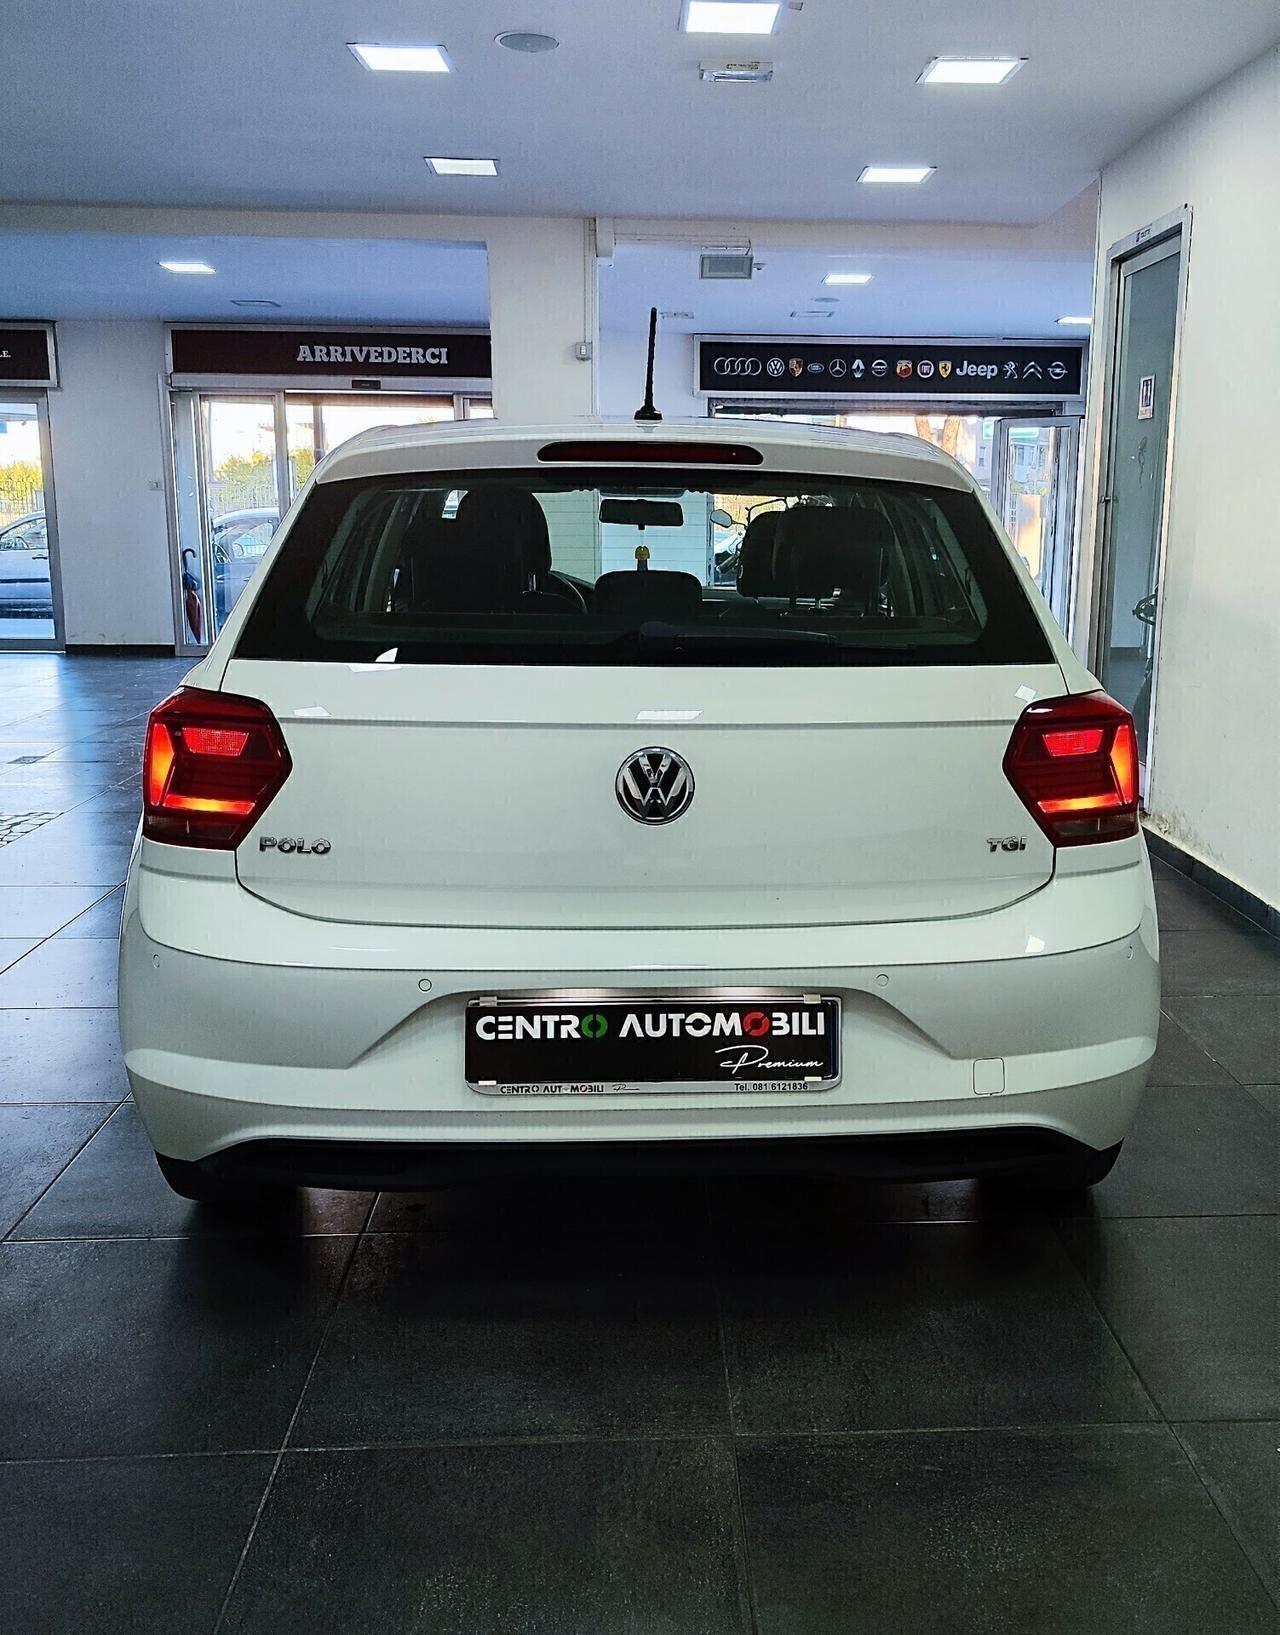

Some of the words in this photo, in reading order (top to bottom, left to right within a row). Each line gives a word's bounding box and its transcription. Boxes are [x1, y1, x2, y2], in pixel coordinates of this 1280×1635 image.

[0, 350, 11, 358] E.
[297, 345, 448, 364] ARRIVEDERCI
[956, 360, 998, 379] Jeep
[259, 836, 331, 855] POLO
[987, 836, 1027, 852] TGI
[475, 1014, 608, 1040] CENTRO
[618, 1011, 825, 1038] AUTOMOBILI
[715, 1045, 823, 1074] Premium
[500, 1086, 539, 1094] CENTRO
[734, 1083, 749, 1091] Tel.
[752, 1083, 767, 1091] 081
[771, 1082, 808, 1091] 6121836
